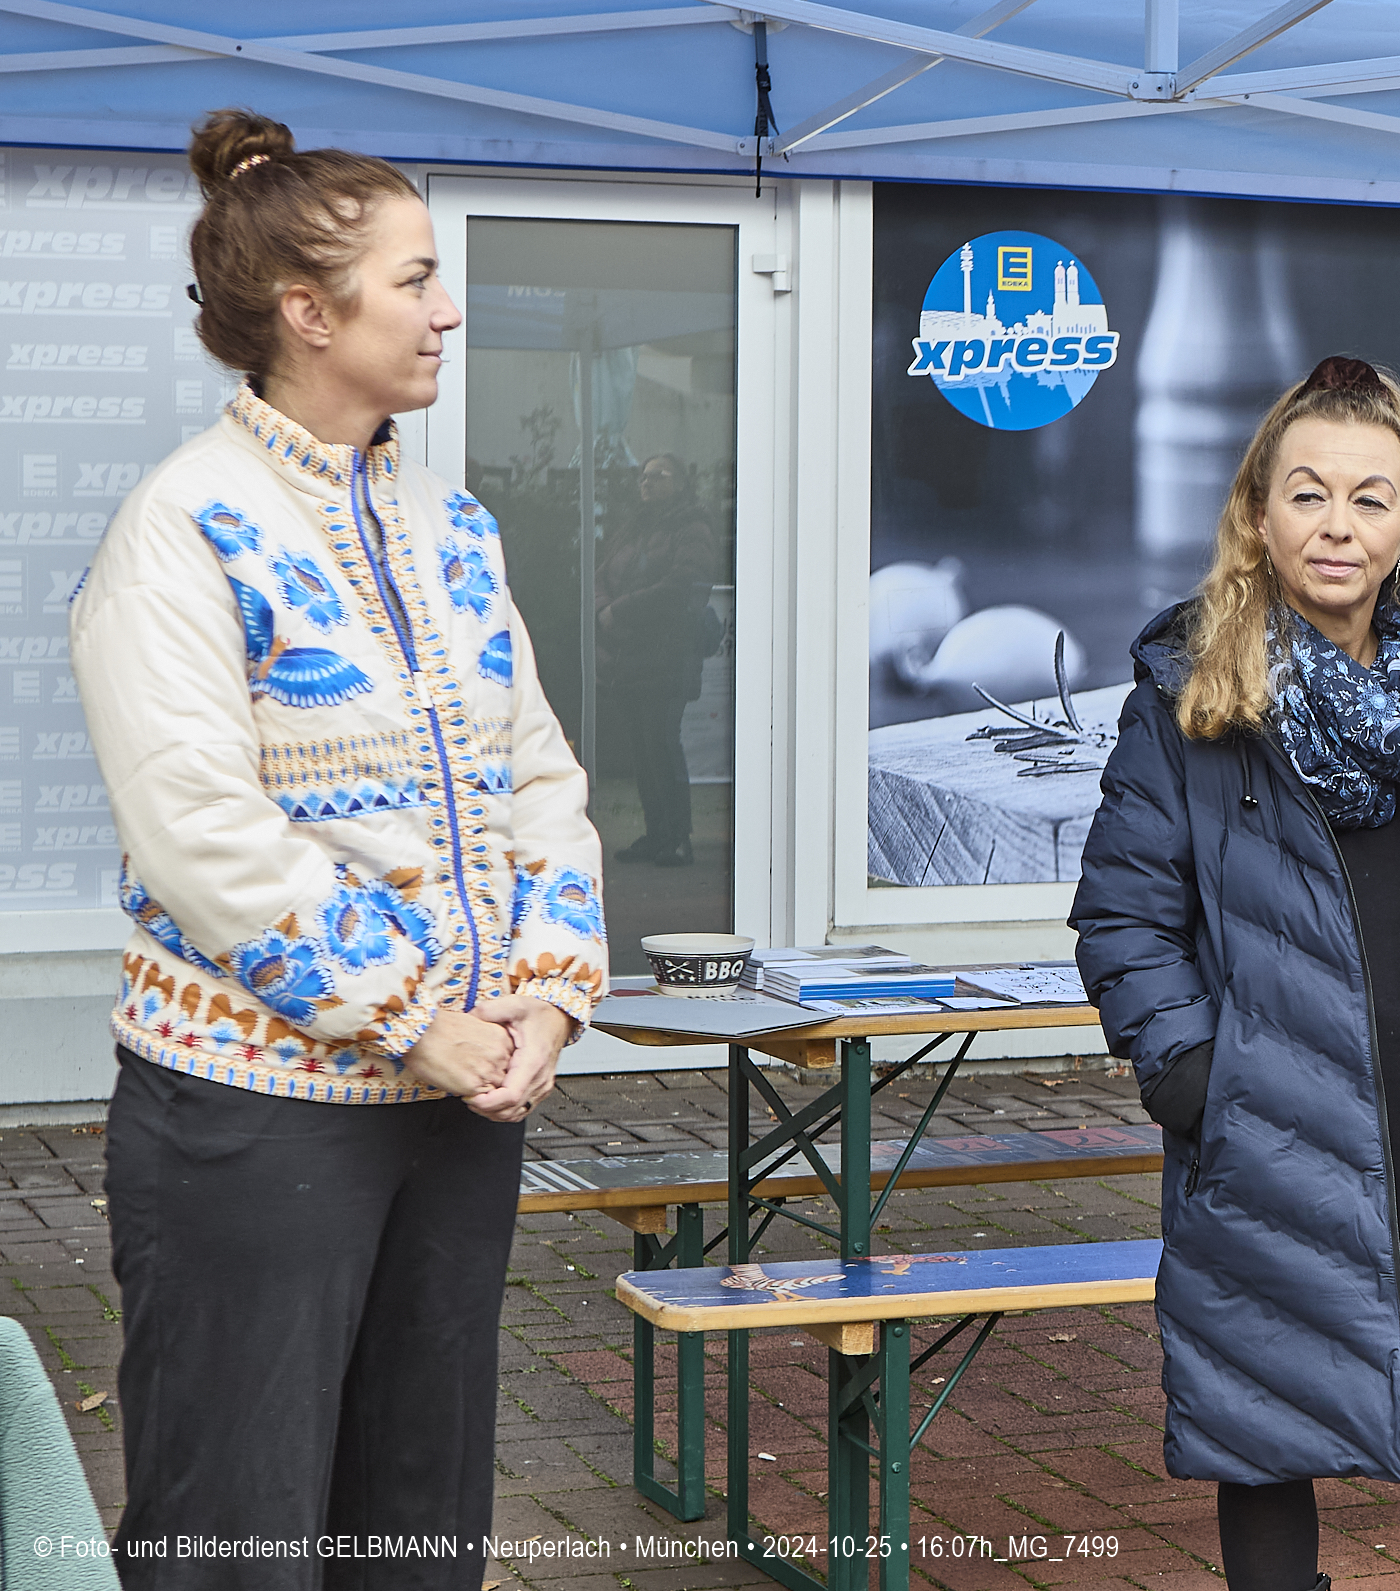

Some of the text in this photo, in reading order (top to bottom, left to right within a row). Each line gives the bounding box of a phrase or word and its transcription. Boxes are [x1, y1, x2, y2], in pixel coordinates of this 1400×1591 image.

[0, 230, 125, 258] press
[0, 281, 172, 315] xpress
[6, 343, 148, 370] xpress
[911, 335, 1118, 379] xpress
[0, 395, 146, 422] xpress
[705, 960, 744, 981] BBQ
